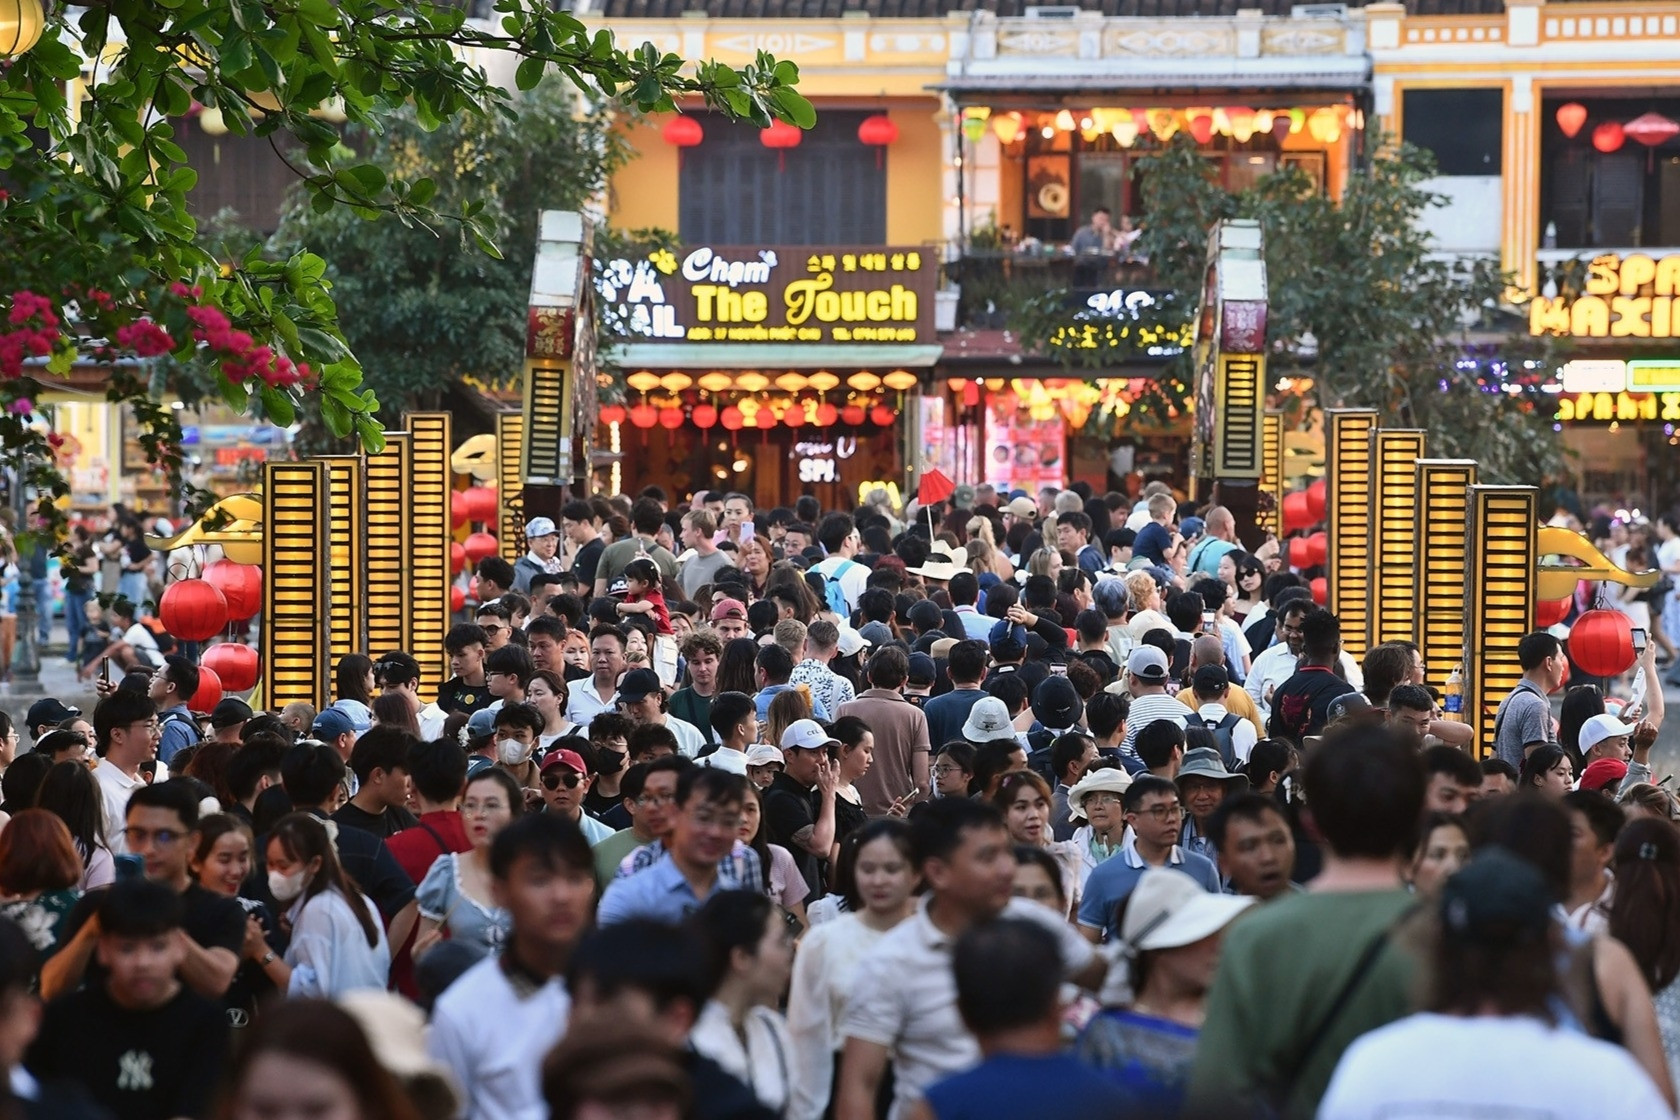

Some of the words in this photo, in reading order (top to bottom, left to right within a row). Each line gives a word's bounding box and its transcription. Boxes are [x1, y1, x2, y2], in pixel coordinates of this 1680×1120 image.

[691, 284, 768, 322] The
[784, 272, 917, 325] Touch
[1530, 295, 1680, 338] MAXI
